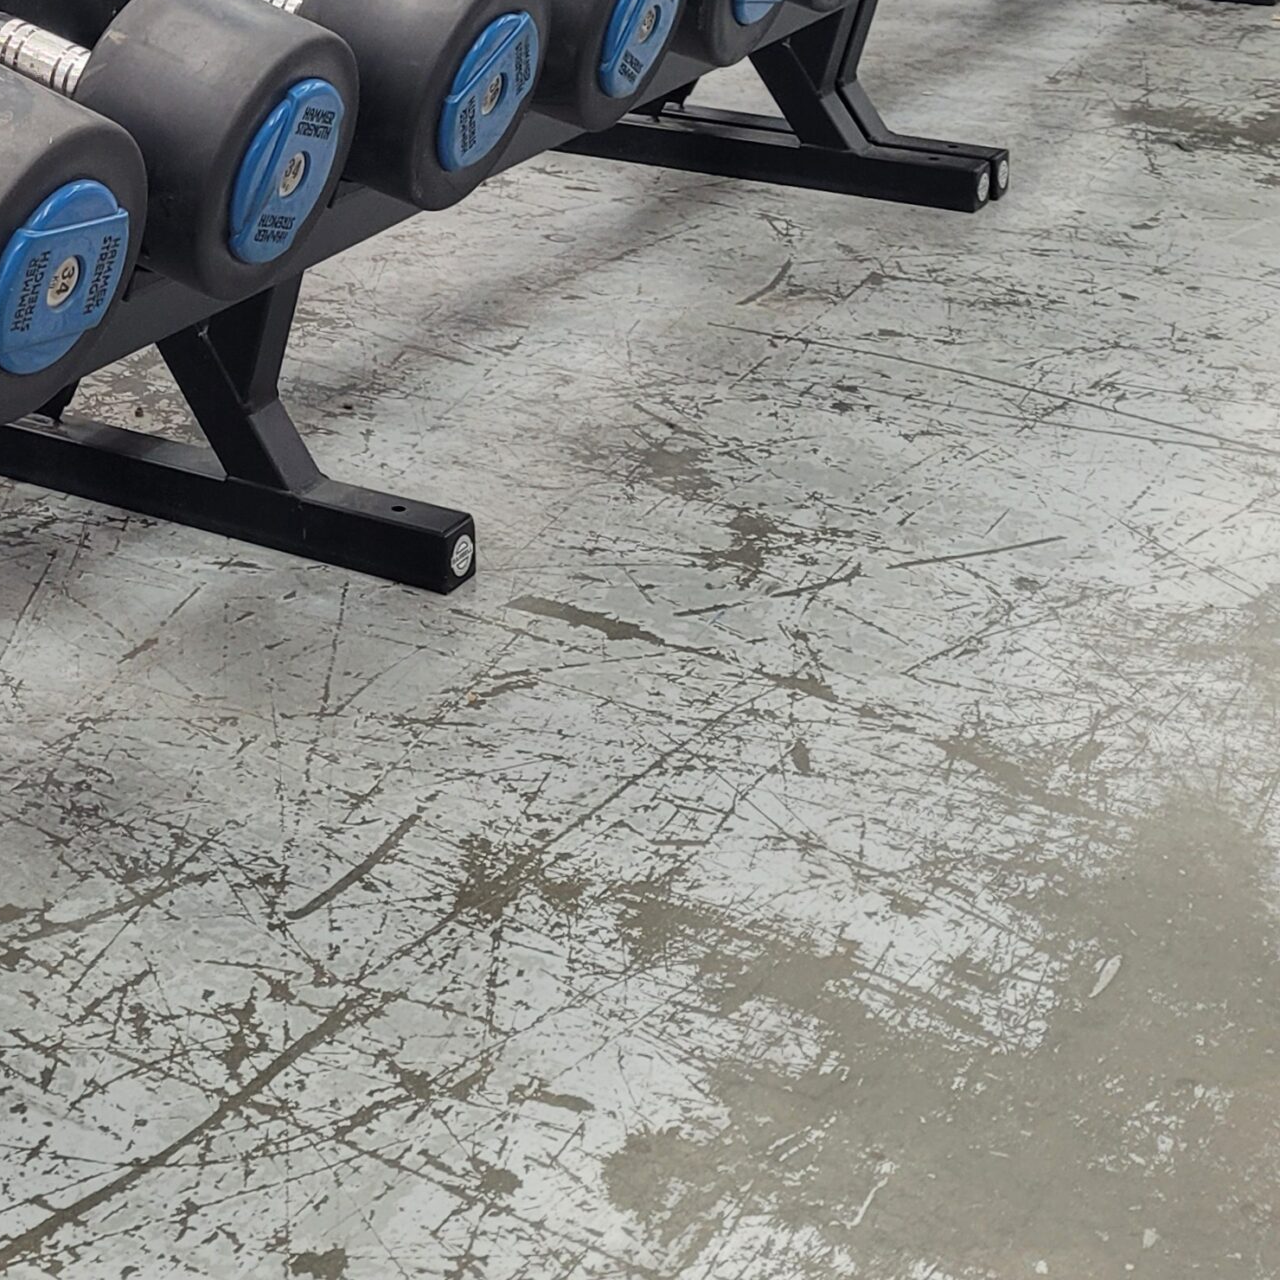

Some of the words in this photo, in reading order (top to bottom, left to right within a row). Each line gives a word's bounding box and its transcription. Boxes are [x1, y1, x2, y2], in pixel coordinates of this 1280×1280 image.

[302, 106, 336, 125] HAMMER
[295, 122, 331, 141] STRENGTH
[285, 158, 303, 179] 34
[257, 214, 295, 230] STRENGTH
[56, 265, 75, 296] 34
[83, 235, 113, 314] STRENGTH
[95, 237, 121, 308] HAMMER
[10, 258, 38, 332] HAMMER
[20, 250, 51, 332] STRENGTH
